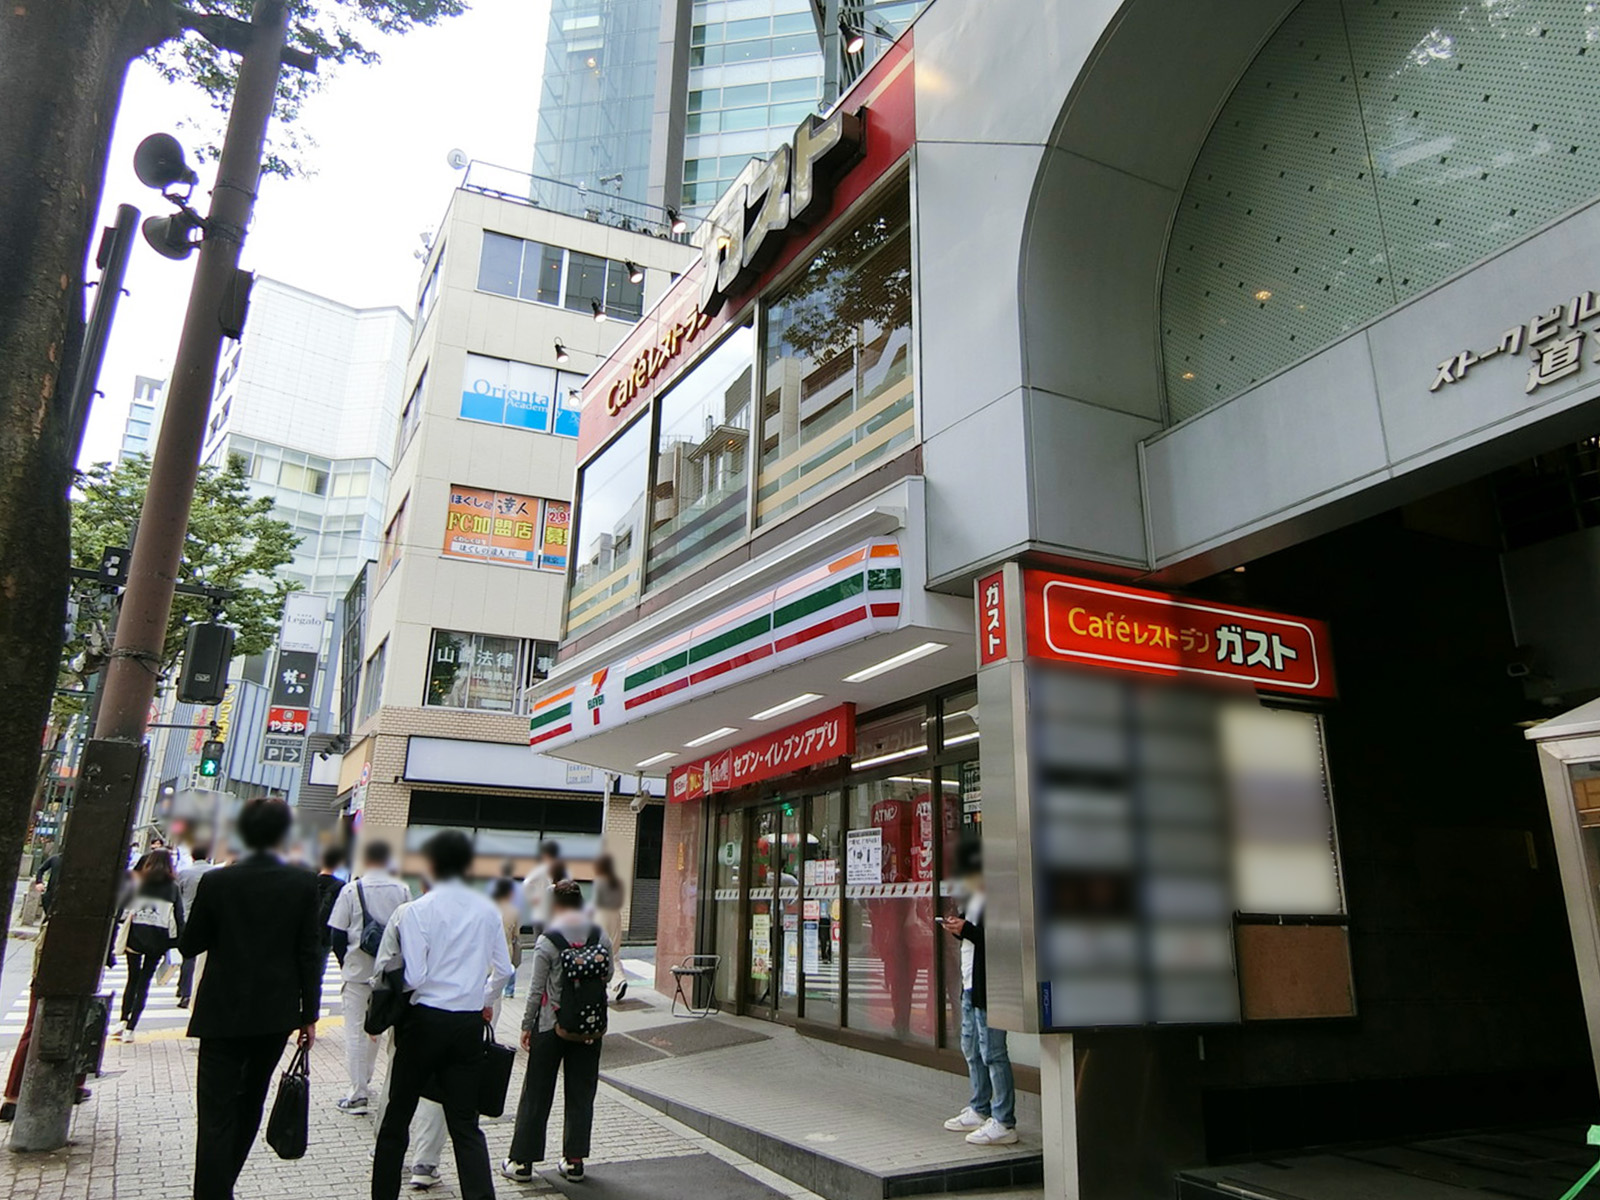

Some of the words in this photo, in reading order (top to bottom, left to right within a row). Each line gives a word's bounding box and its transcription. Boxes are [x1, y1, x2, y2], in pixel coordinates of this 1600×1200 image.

[700, 111, 860, 316] ガスト
[1525, 325, 1600, 394] 道
[472, 378, 563, 411] Oriental
[506, 399, 563, 419] Academy
[986, 582, 1001, 656] ガスト
[1068, 607, 1210, 654] Caféレストラン
[1215, 624, 1298, 671] ガスト
[270, 720, 304, 734] やまや
[734, 720, 838, 777] セブン・イレブンアプリ
[267, 748, 279, 760] P
[873, 805, 892, 823] ATM
